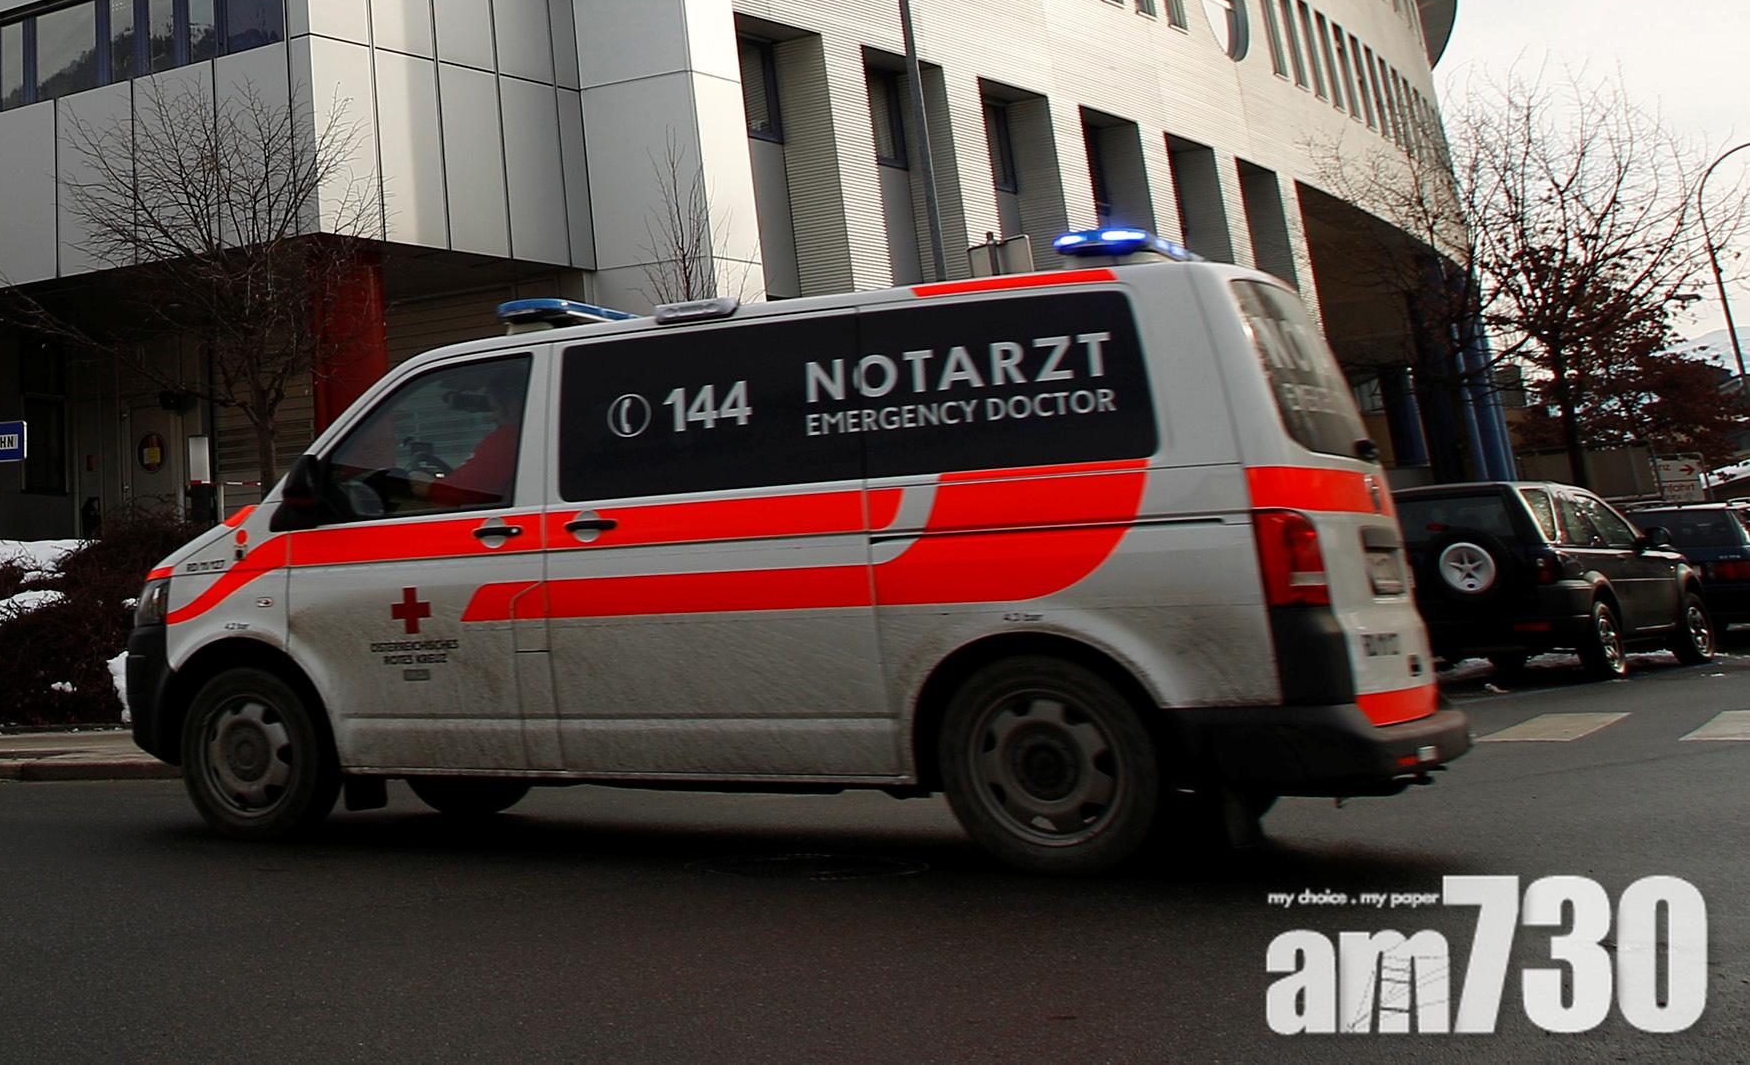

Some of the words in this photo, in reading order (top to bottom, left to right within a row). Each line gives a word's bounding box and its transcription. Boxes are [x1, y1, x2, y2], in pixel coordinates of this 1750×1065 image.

[805, 332, 1111, 403] NOTARZT
[663, 380, 753, 433] 144
[806, 399, 979, 436] EMERGENCY
[987, 388, 1118, 422] DOCTOR
